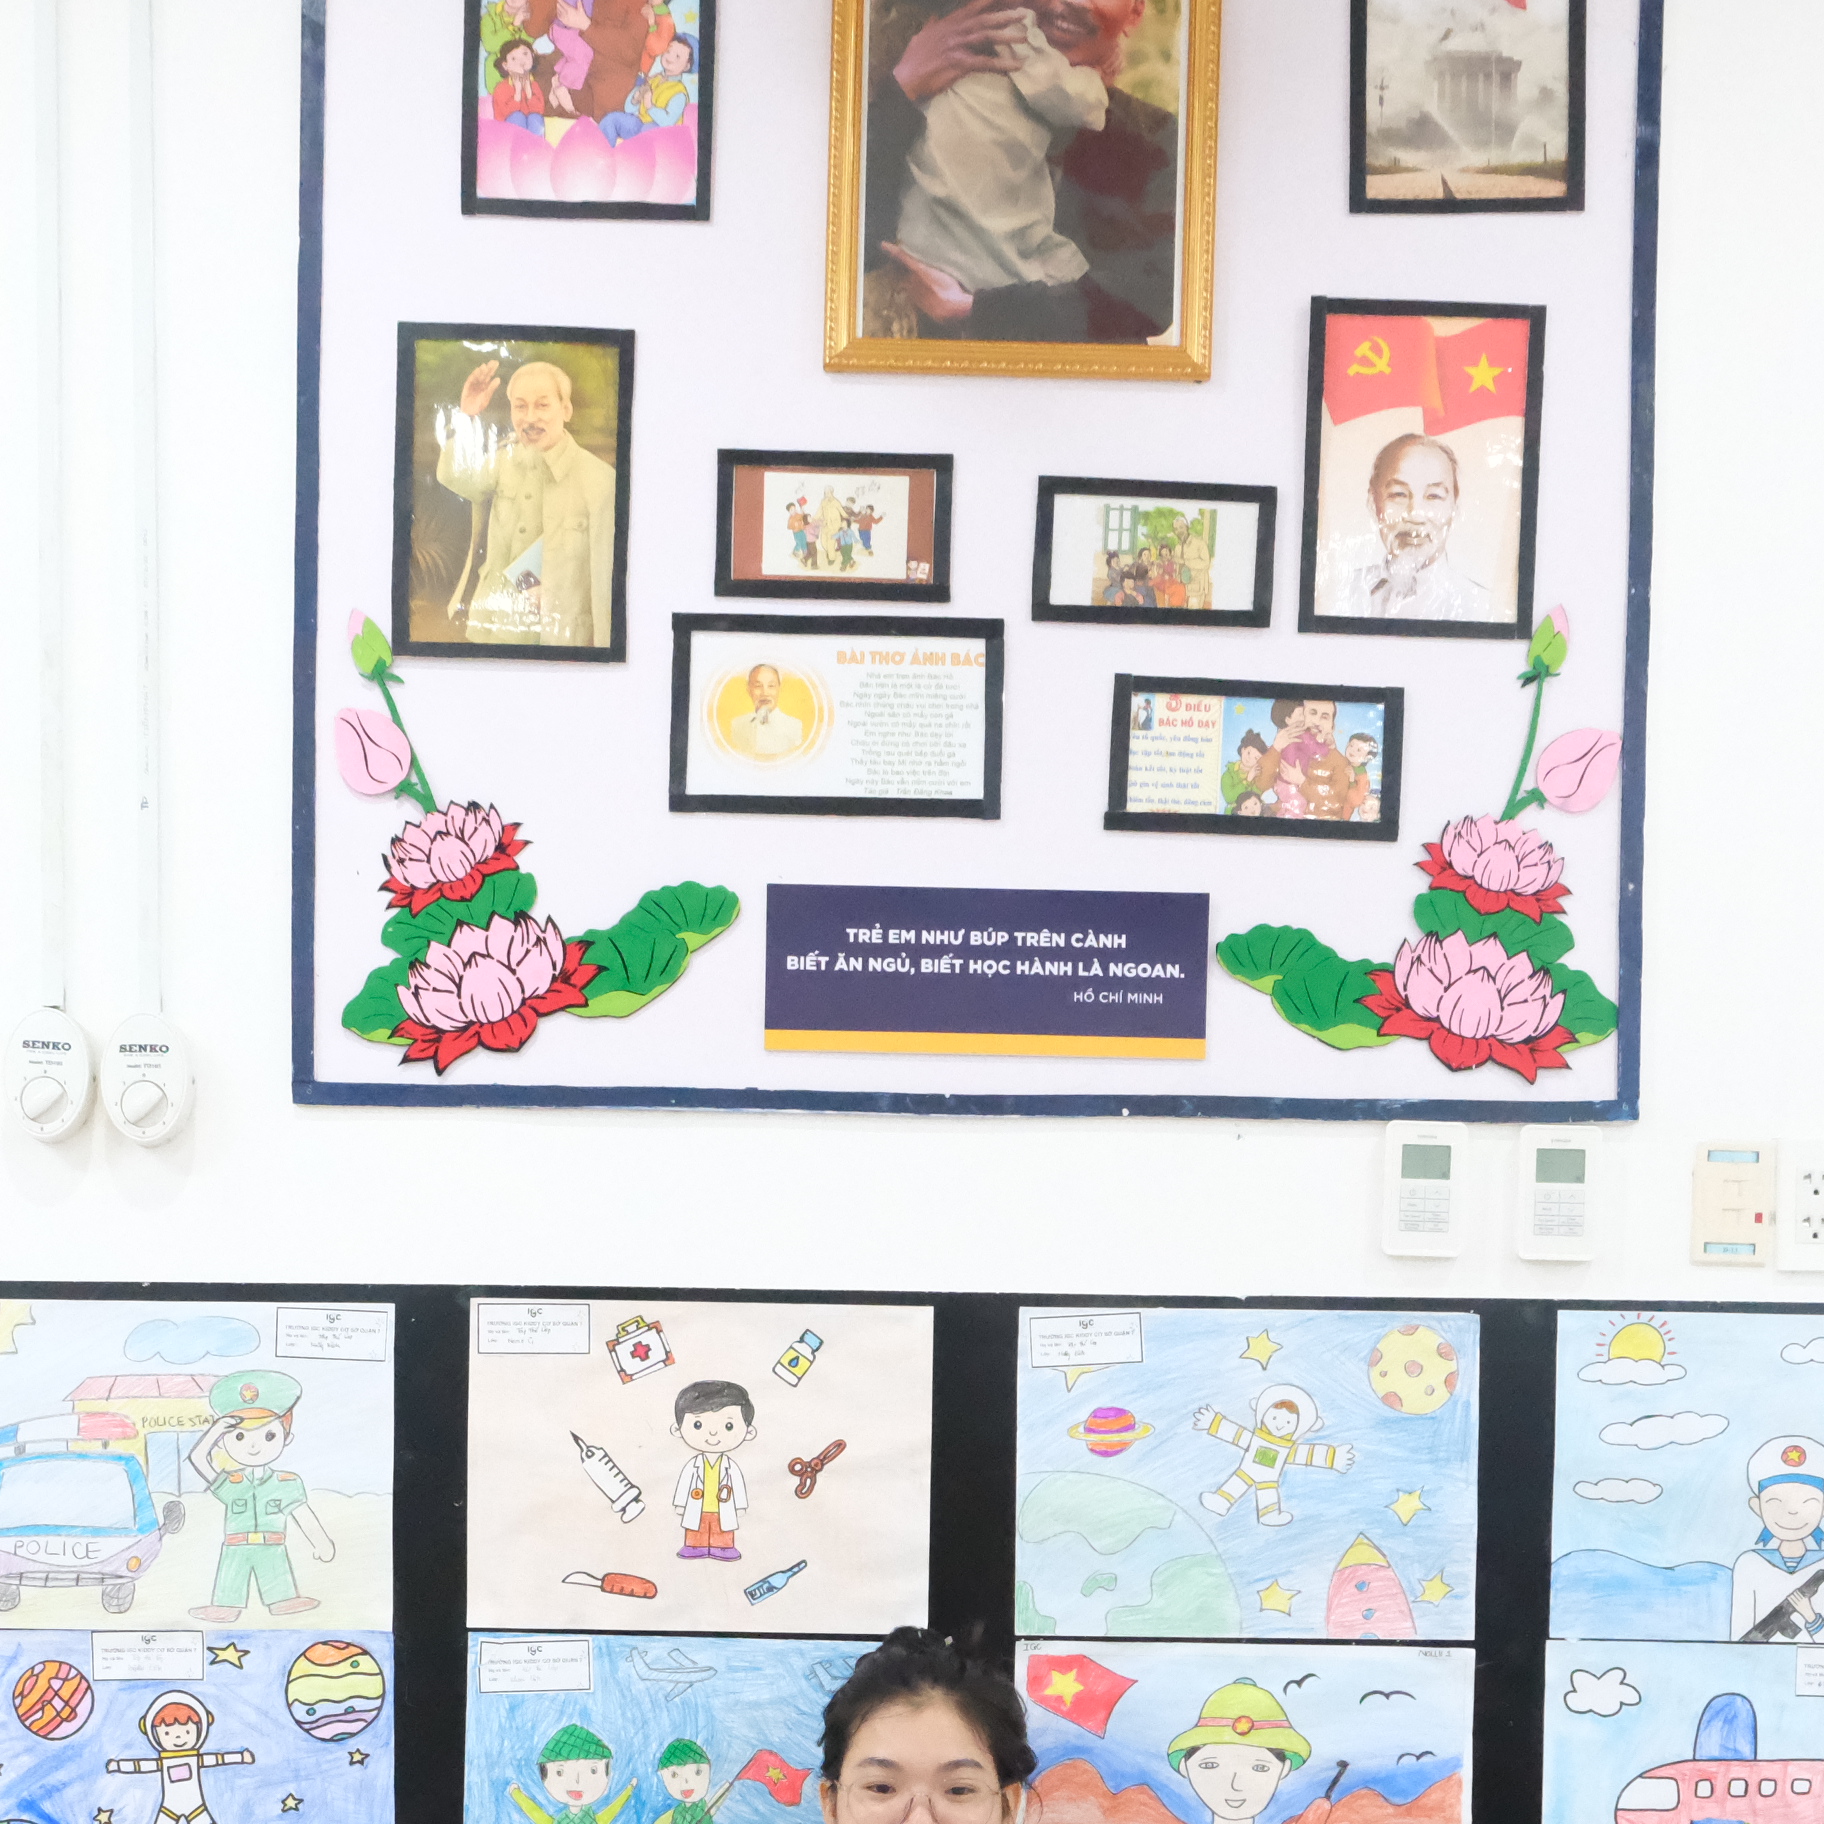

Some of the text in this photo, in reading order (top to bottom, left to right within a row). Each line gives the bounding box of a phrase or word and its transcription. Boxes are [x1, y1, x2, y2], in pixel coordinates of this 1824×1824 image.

[846, 923, 1127, 950] TRẺ EM NHƯ BÚP TRÊN CÀNH
[786, 950, 1186, 980] BIẾT ĂN NGỦ, BIẾT HỌC HÀNH LÀ NGOAN.
[1073, 987, 1163, 1005] HỒ CHÍ MINH
[22, 1040, 72, 1051] SENKO
[119, 1044, 169, 1053] SENKO
[142, 1415, 185, 1428] POLICE
[14, 1540, 102, 1560] POLICE
